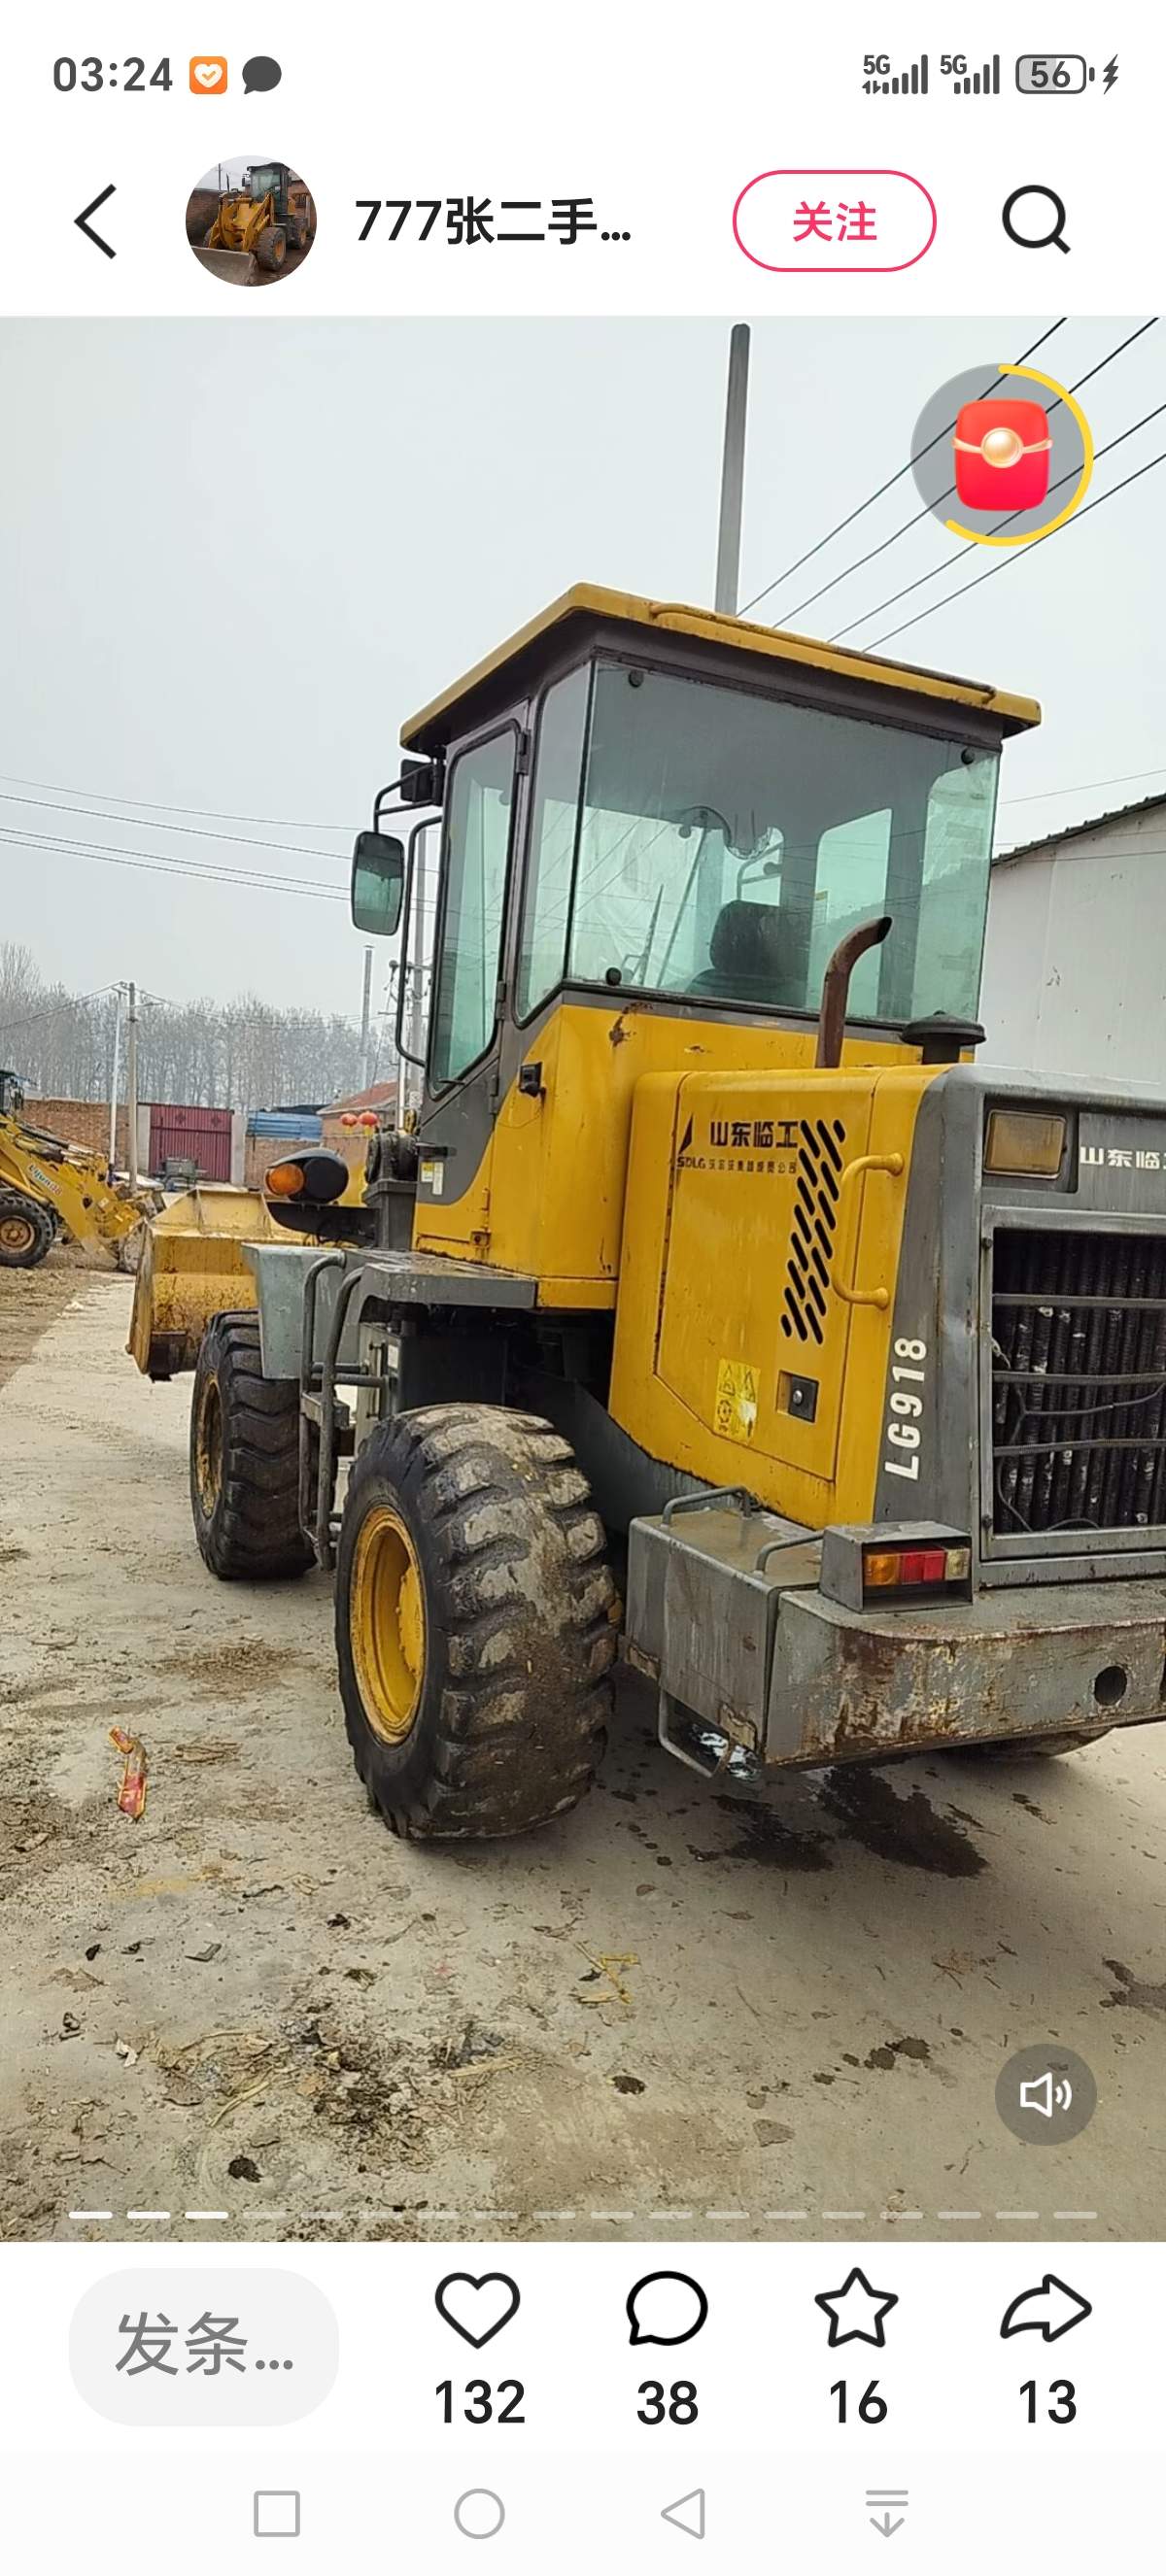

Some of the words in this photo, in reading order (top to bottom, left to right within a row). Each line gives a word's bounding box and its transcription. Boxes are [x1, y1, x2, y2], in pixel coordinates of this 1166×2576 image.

[710, 1120, 799, 1149] 山东临工
[677, 1156, 706, 1169] SDLG
[1080, 1146, 1166, 1170] 山东临
[884, 1338, 927, 1481] LG918
